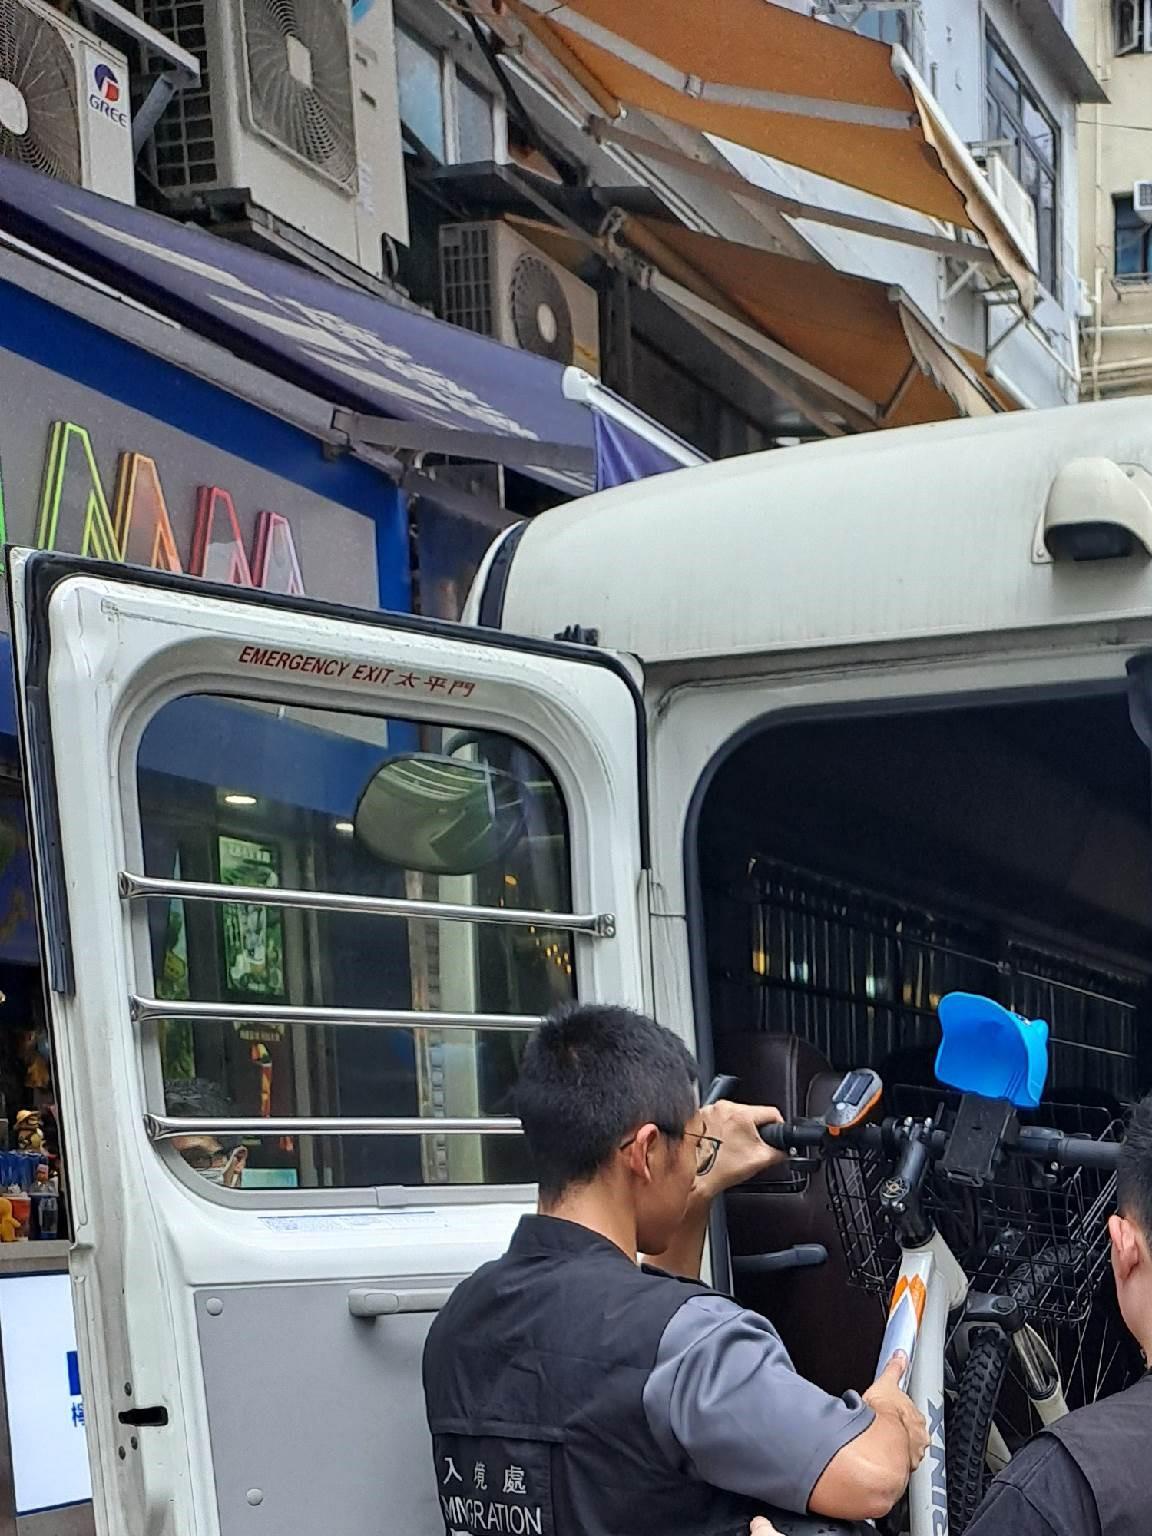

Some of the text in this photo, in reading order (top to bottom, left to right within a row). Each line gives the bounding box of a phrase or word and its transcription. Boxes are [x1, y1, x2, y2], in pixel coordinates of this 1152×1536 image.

[89, 93, 128, 128] GREE
[238, 646, 394, 685] EMERGENCY EXIT
[395, 671, 476, 697] 太平門
[443, 1457, 527, 1495] 入境處
[441, 1495, 543, 1536] MMGRATION
